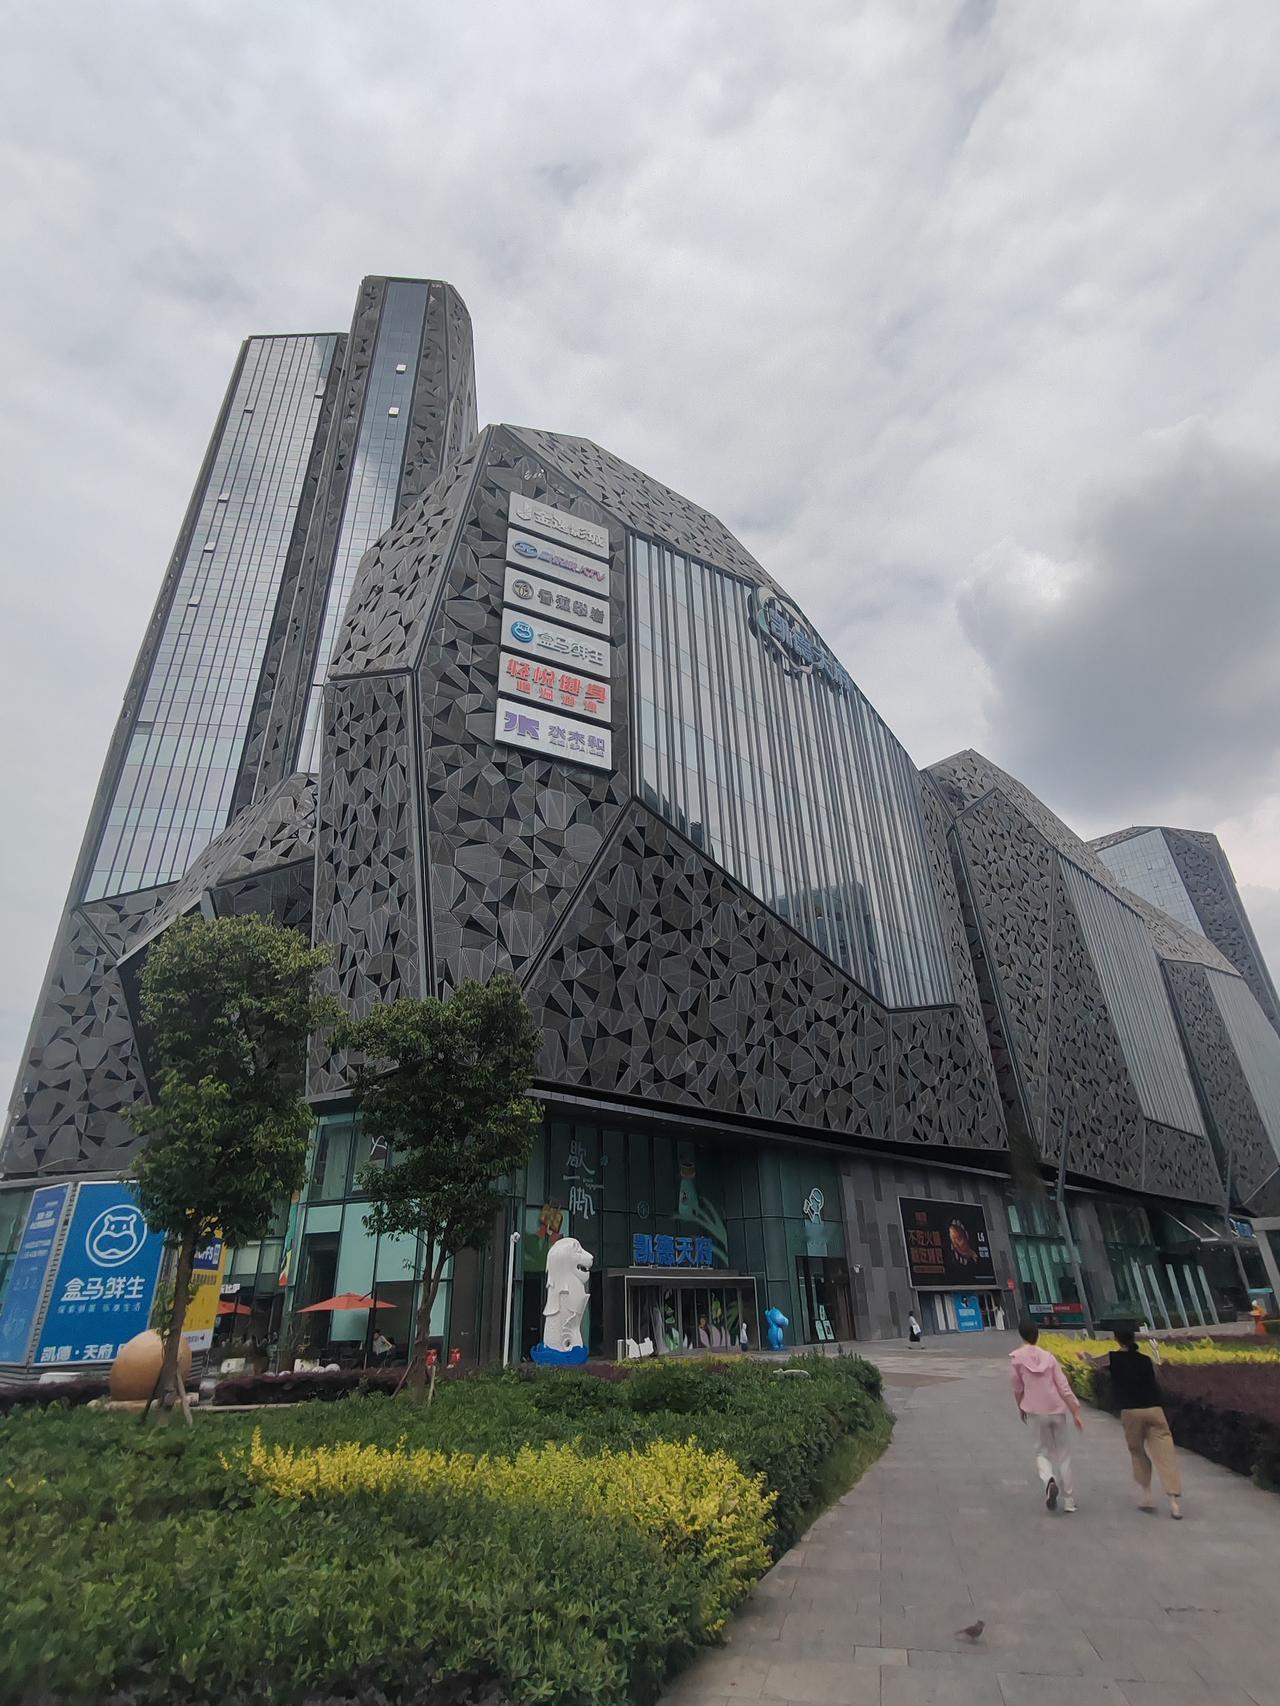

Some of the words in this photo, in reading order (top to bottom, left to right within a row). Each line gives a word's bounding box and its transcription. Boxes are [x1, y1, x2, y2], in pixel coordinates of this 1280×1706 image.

[537, 632, 604, 667] 盒马鲜生
[506, 658, 608, 704] 轻悦健身
[632, 1232, 713, 1265] 凯德天府
[60, 1275, 146, 1302] 盒马鲜生
